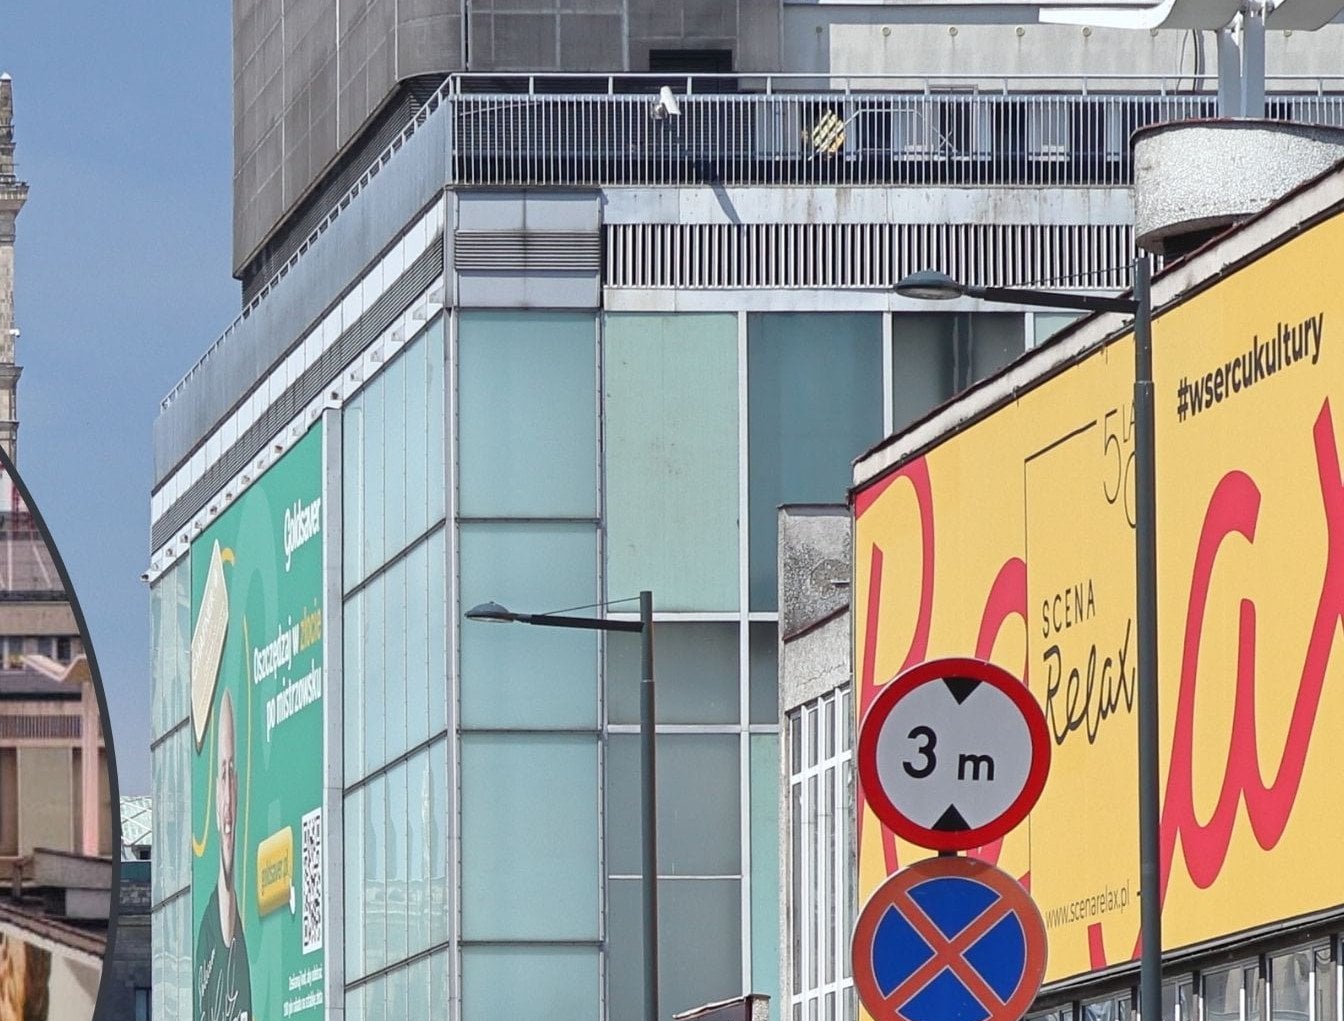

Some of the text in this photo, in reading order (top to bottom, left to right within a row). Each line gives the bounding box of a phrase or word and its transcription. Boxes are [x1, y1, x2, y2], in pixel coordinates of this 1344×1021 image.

[1177, 312, 1324, 423] #wsercukultury
[284, 498, 321, 572] Goldsaver
[1043, 579, 1096, 638] SCENA
[254, 614, 292, 685] Oszczędzaj
[1043, 618, 1135, 746] Relax
[267, 658, 321, 742] po mistrzowsku
[903, 726, 995, 781] 3 m
[1045, 879, 1130, 930] www.scenarelax.pl
